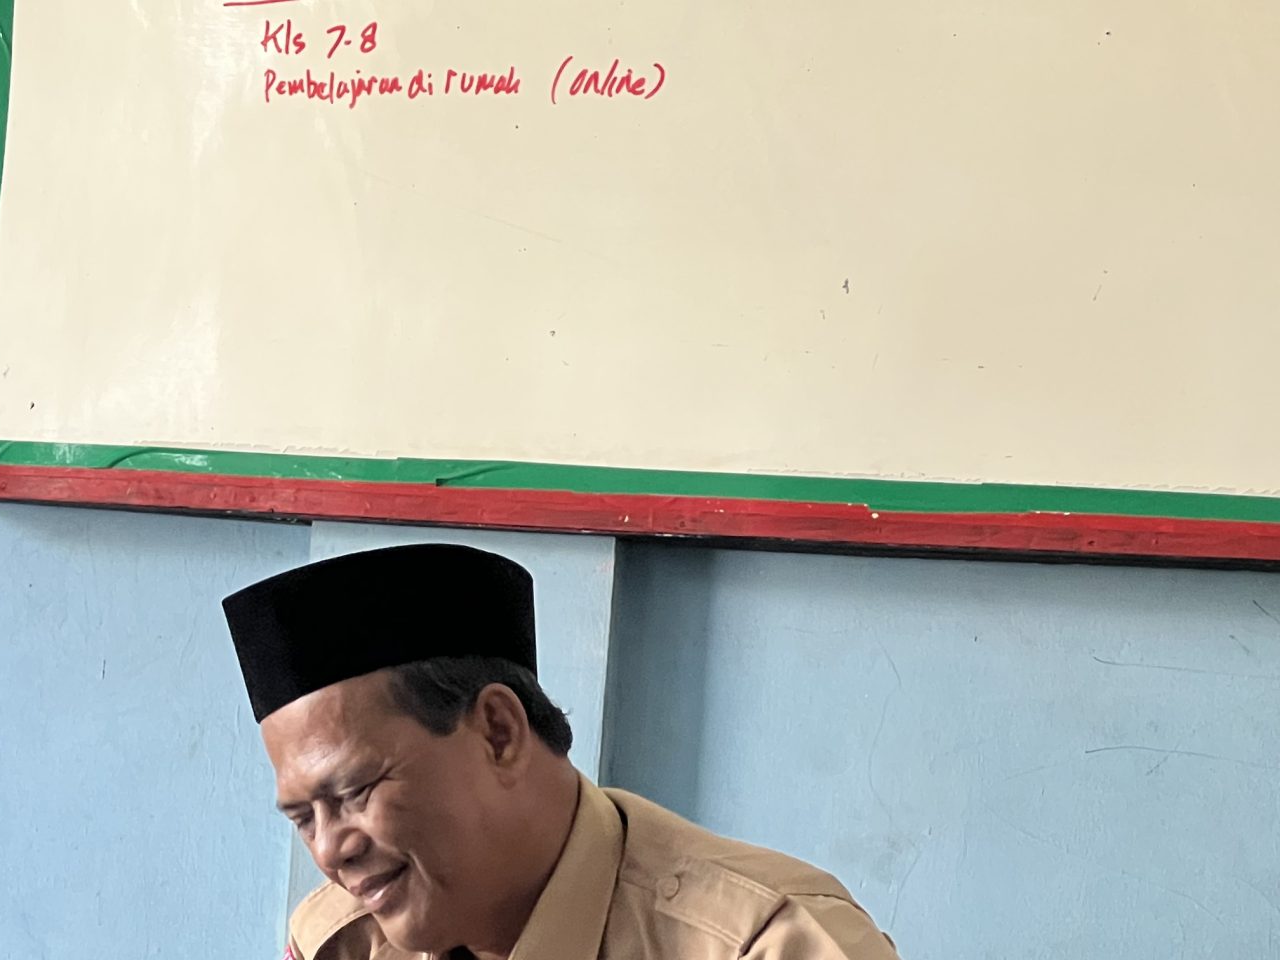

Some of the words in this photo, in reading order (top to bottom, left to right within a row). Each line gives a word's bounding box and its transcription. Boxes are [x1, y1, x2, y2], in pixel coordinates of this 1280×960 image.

[260, 19, 306, 55] Kls
[408, 68, 434, 99] di
[444, 66, 520, 95] rumah
